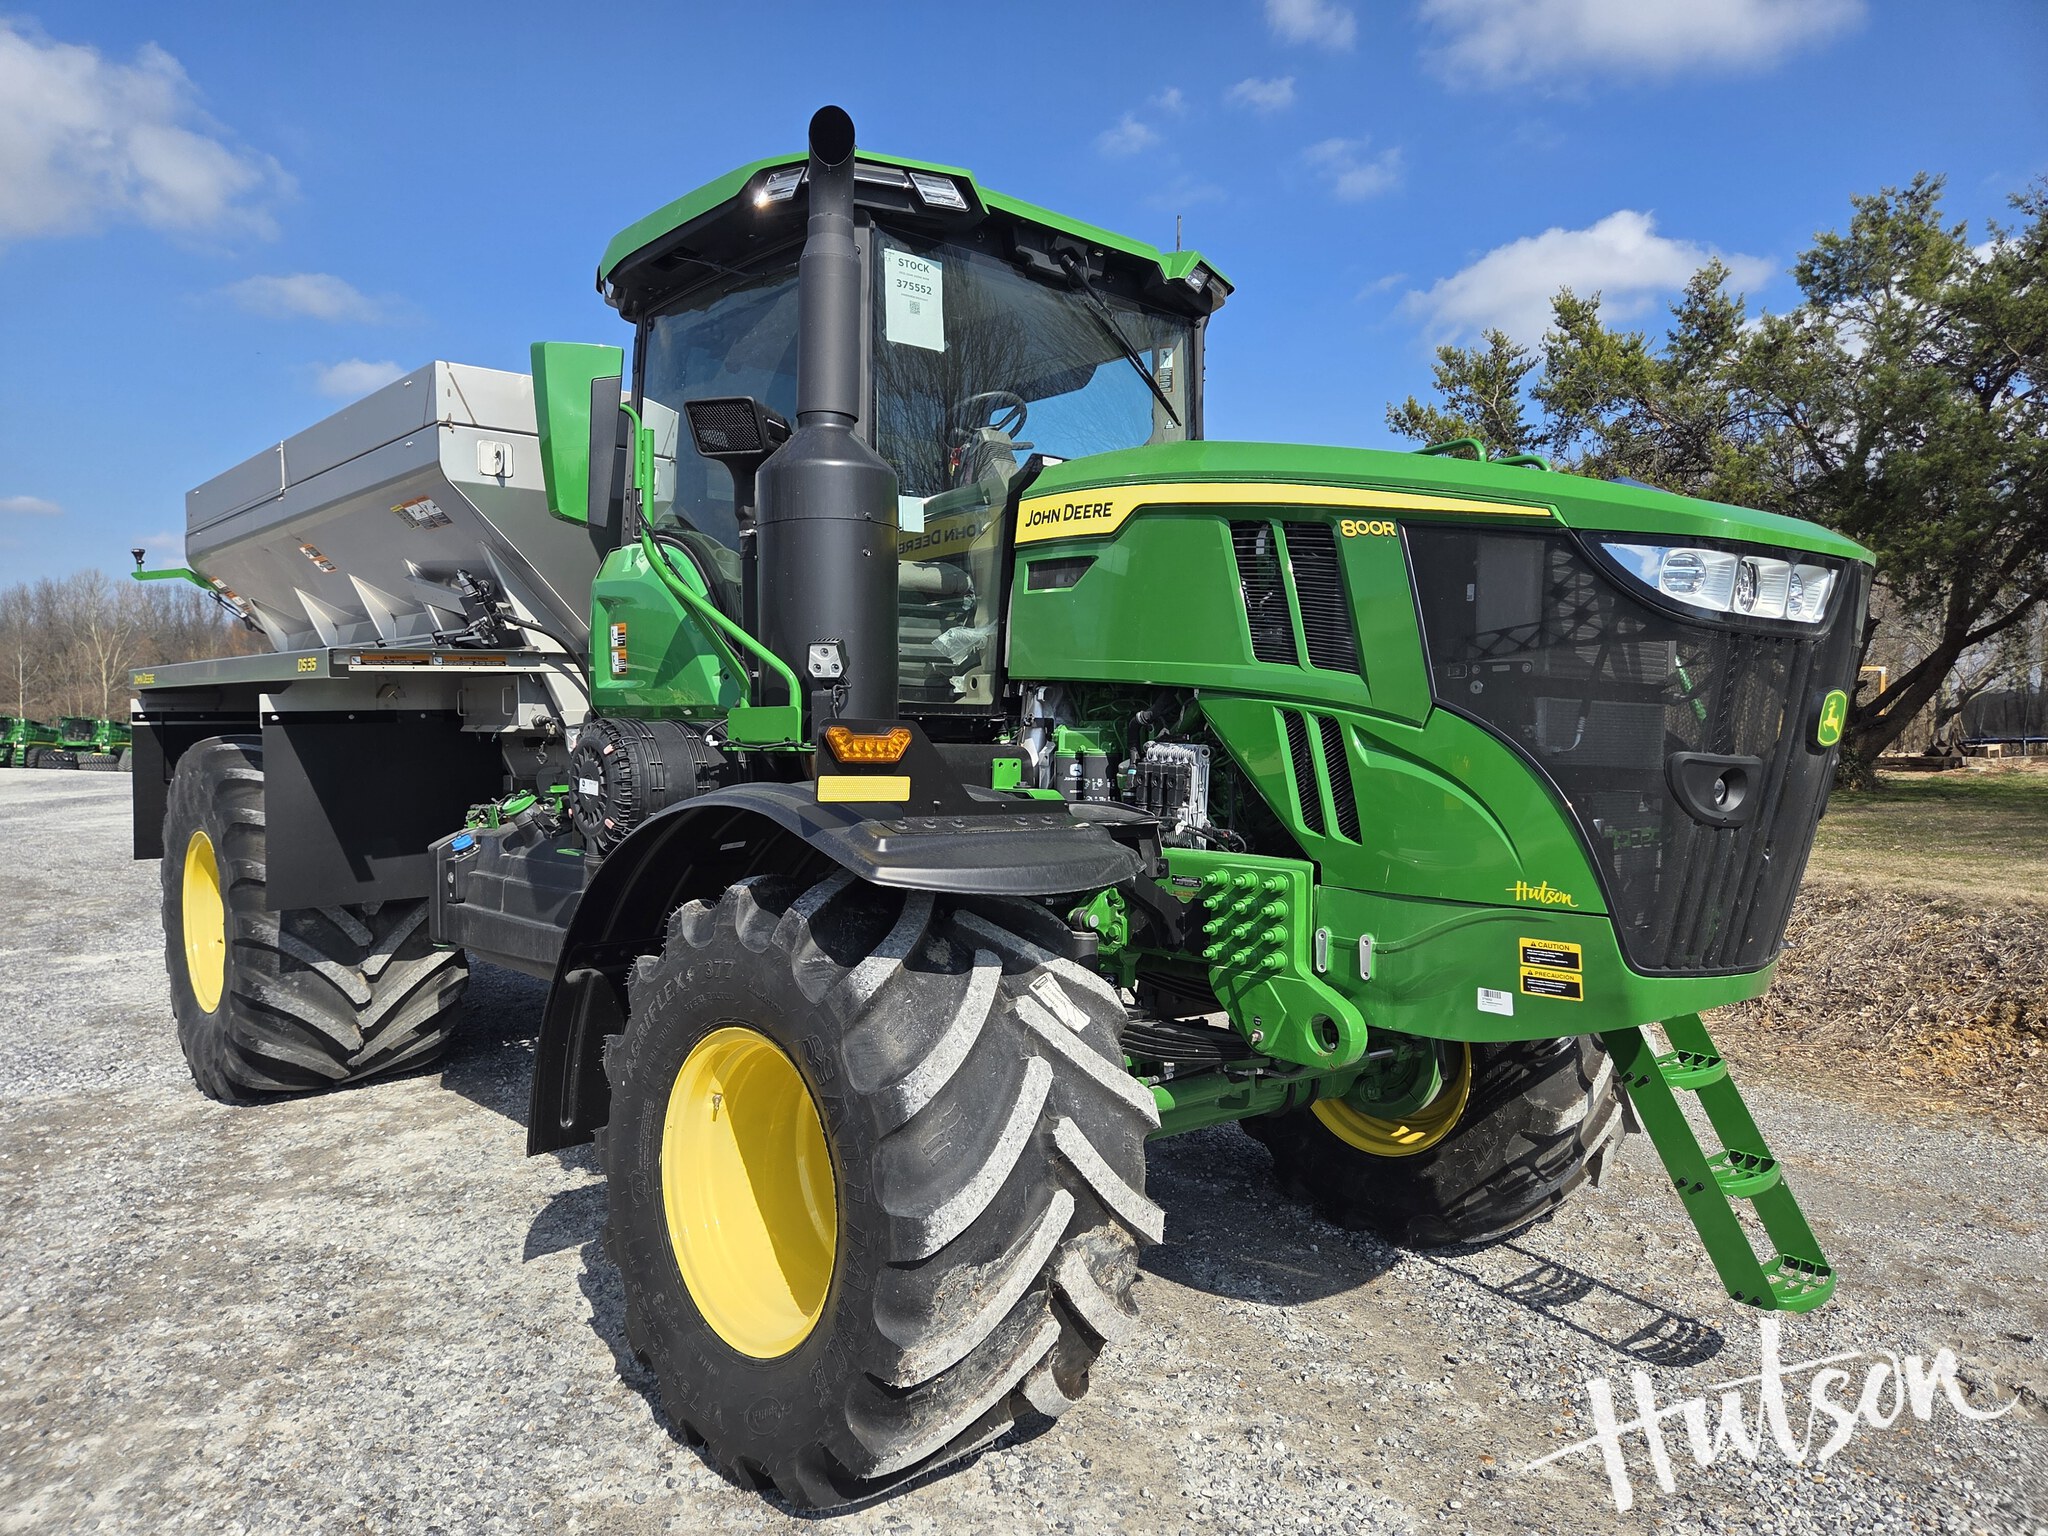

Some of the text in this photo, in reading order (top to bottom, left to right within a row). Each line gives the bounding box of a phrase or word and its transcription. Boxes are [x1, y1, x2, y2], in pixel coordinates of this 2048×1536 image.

[898, 258, 930, 273] STOCK
[897, 279, 932, 295] 375552
[1025, 501, 1114, 527] JOHN DEERE
[1339, 519, 1396, 538] 800R
[297, 657, 317, 673] DS35
[1505, 880, 1579, 907] Hutson
[1538, 941, 1570, 951] CAUTION
[704, 958, 736, 980] 377
[1534, 970, 1575, 982] PRECAUCIÓN
